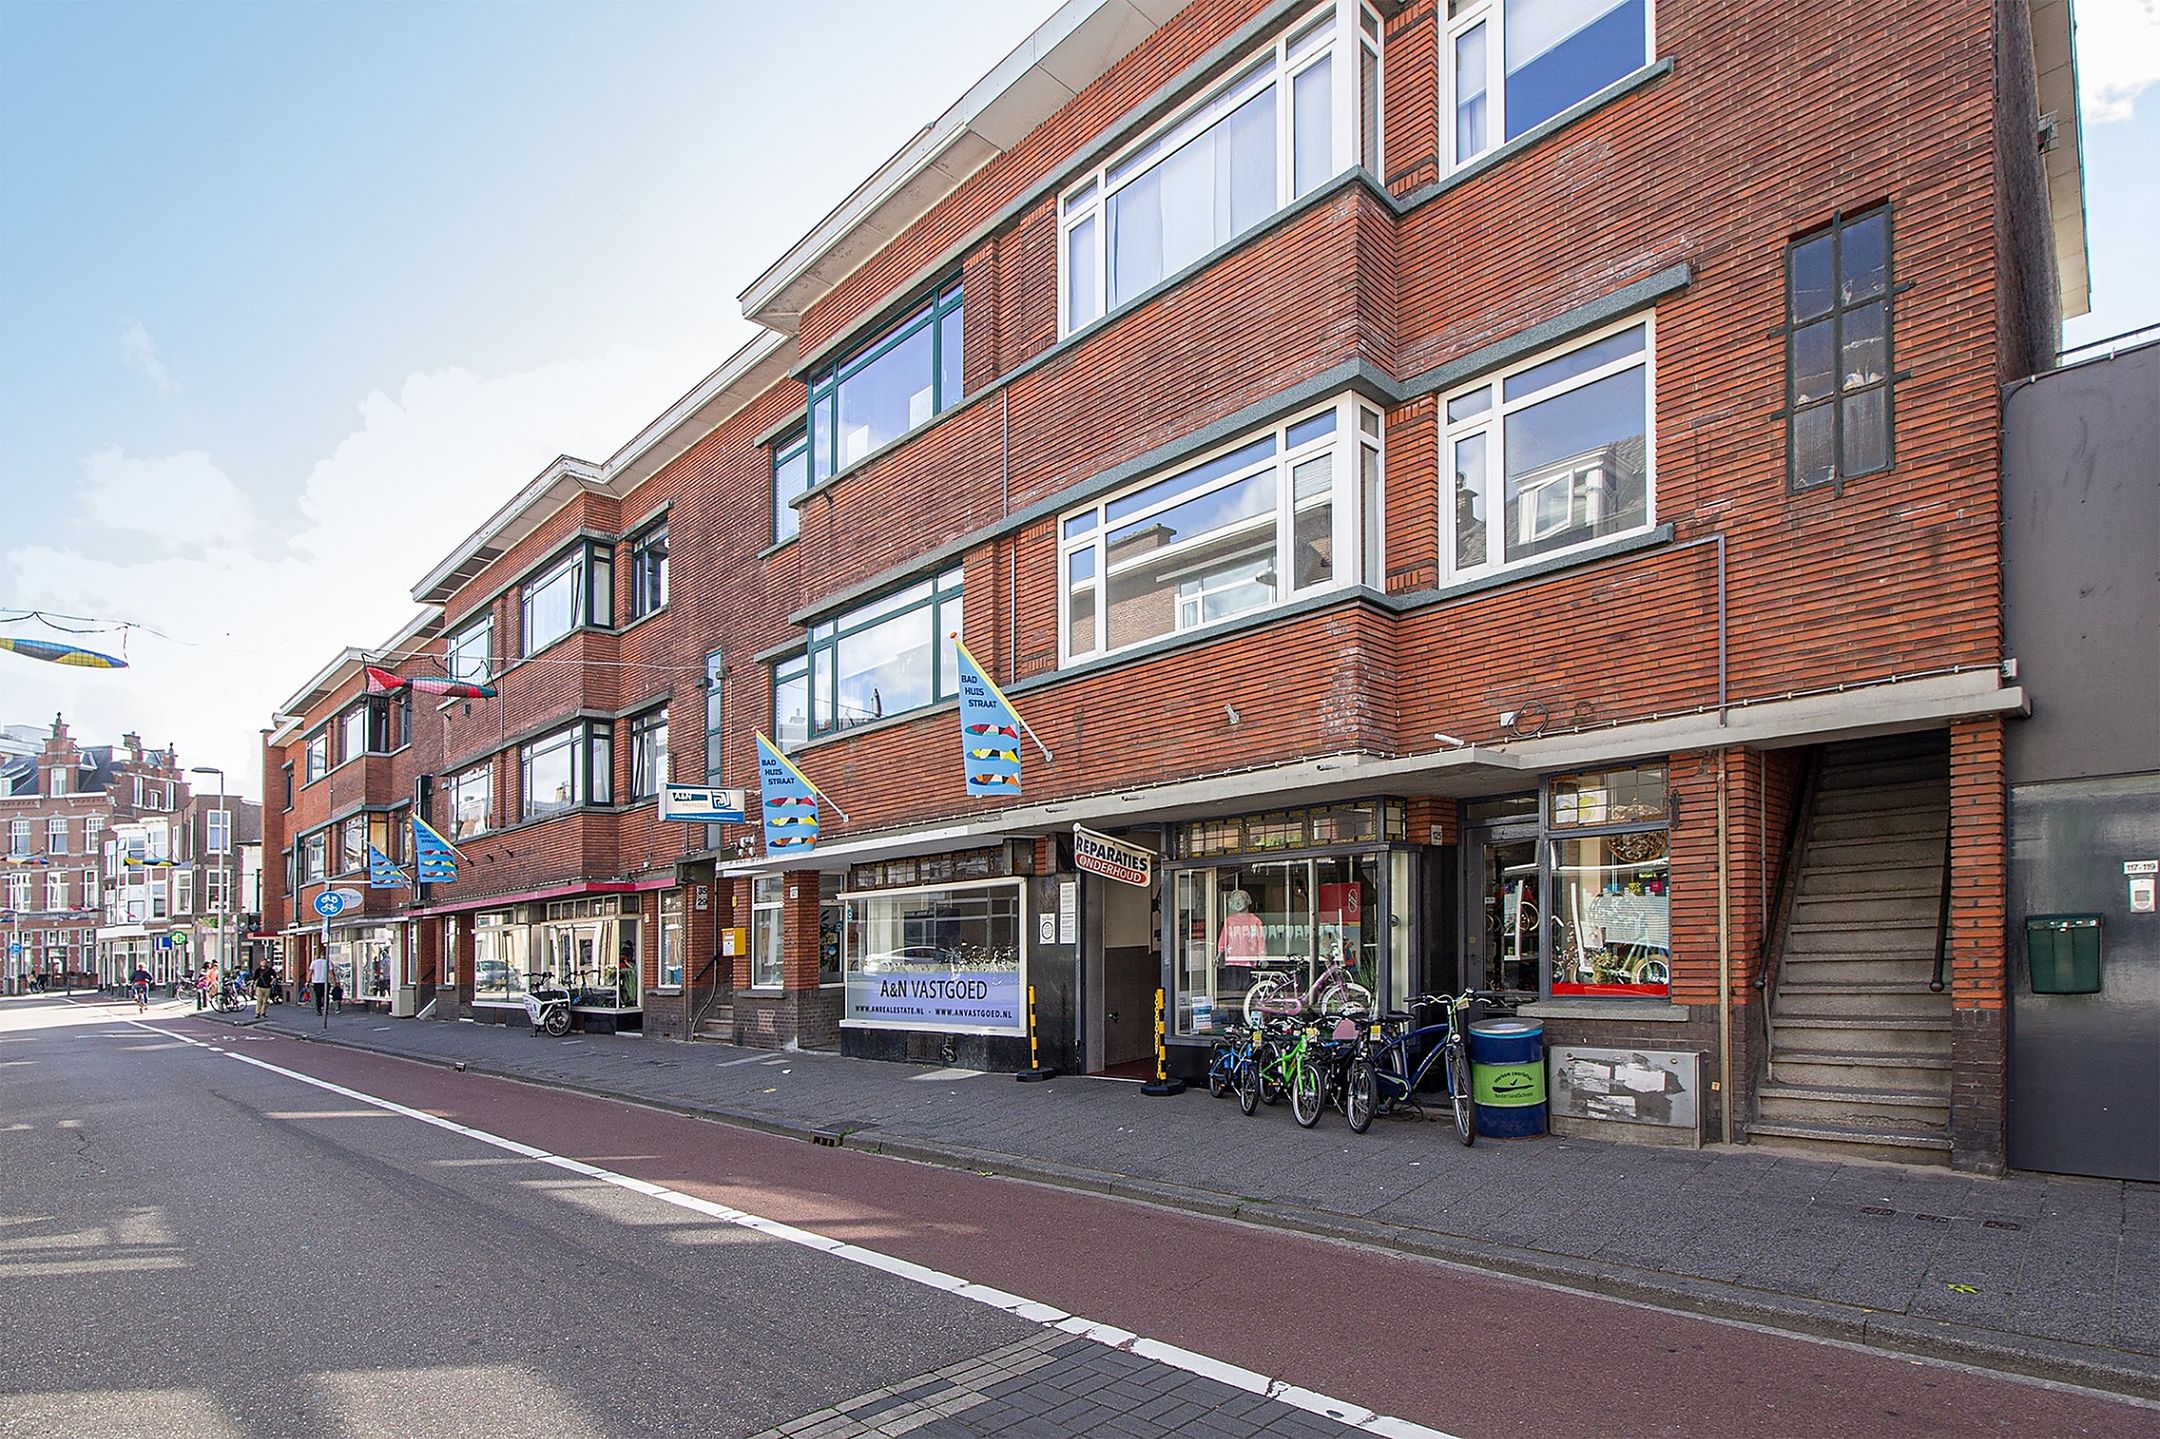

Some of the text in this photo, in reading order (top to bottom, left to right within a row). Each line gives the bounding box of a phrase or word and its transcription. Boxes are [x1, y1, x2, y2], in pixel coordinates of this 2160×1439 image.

[961, 675, 978, 684] BAD
[964, 687, 985, 696] HUIS
[968, 699, 997, 708] STRAAT
[764, 768, 783, 776] HUIS
[768, 777, 795, 785] STRAAT
[1075, 836, 1148, 872] REPARATIES
[1079, 855, 1142, 882] ONDERHOUD
[880, 980, 988, 1000] A&N VASTGOED
[855, 1005, 1012, 1019] WWW.ANREALESTATE.NL WWW.ANVASTGOED.NL
